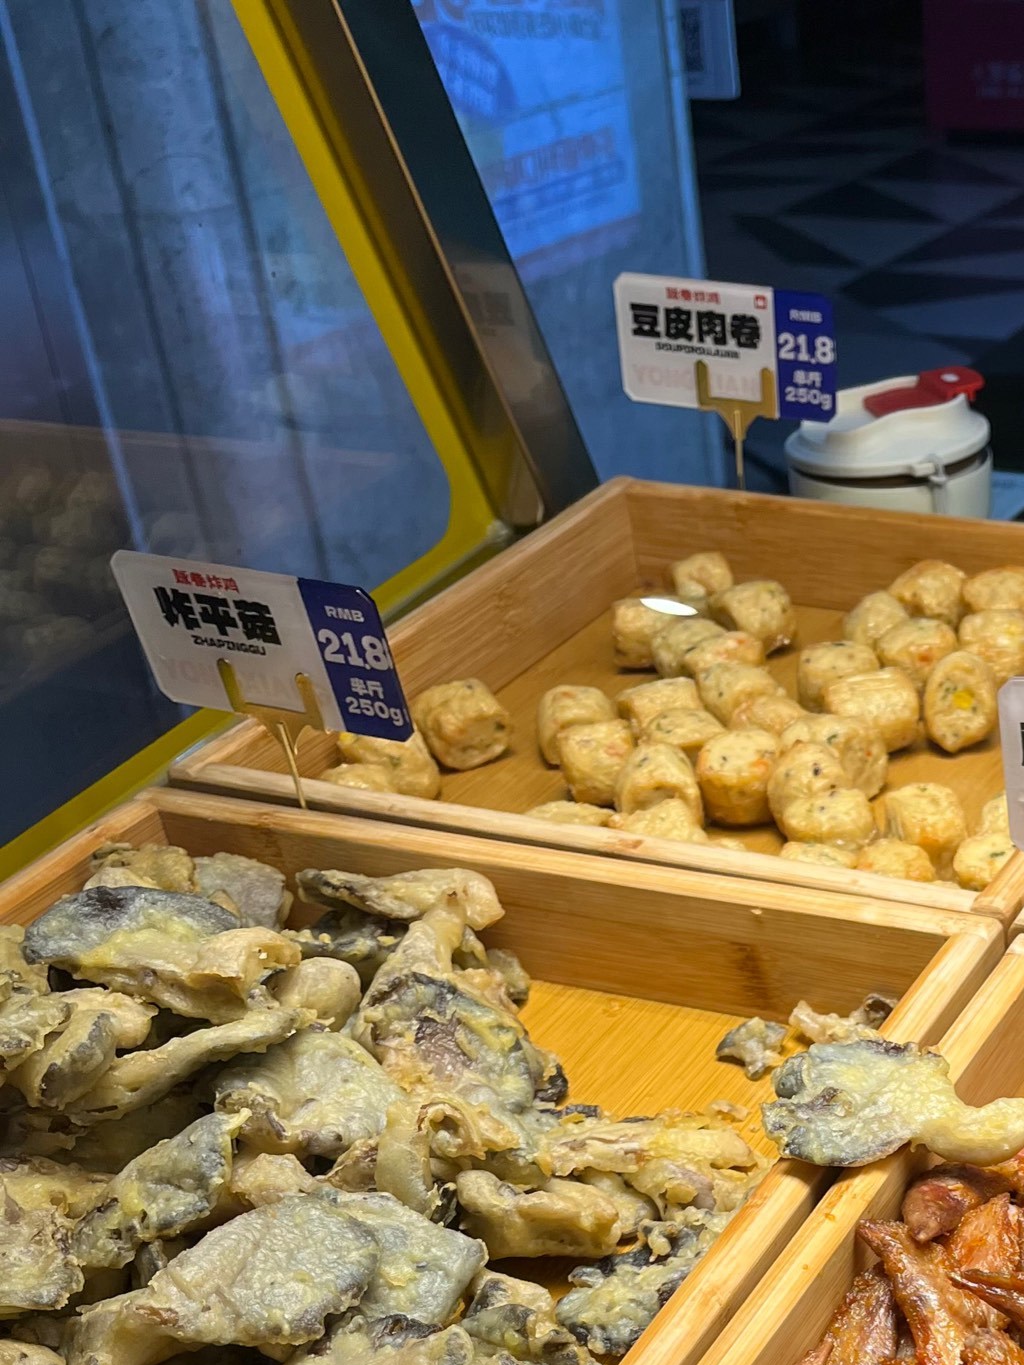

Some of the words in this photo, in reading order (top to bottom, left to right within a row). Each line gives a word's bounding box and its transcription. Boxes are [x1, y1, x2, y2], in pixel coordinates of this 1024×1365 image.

[630, 303, 760, 348] 豆皮肉卷
[778, 332, 834, 364] 21.8
[785, 387, 832, 410] 250g
[153, 586, 281, 645] 炸平菇
[324, 605, 365, 623] RMB
[317, 629, 390, 671] 21.8
[345, 697, 401, 726] 250g
